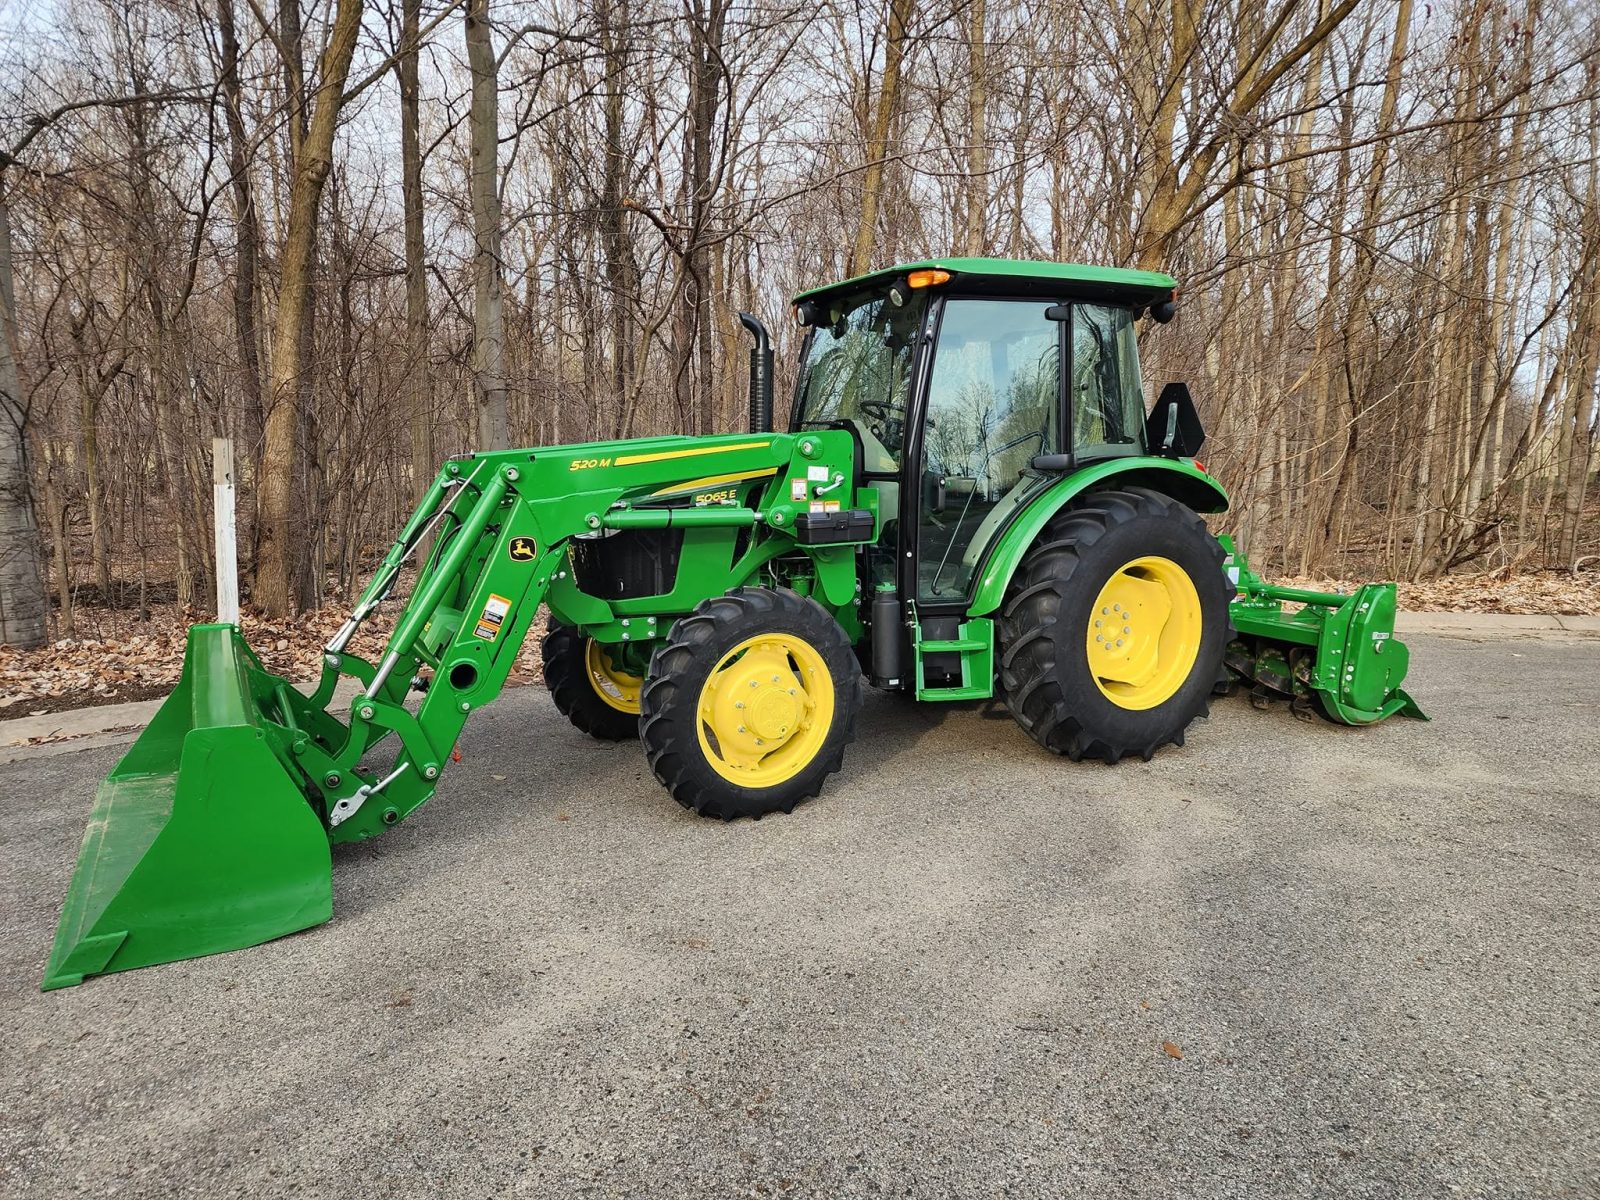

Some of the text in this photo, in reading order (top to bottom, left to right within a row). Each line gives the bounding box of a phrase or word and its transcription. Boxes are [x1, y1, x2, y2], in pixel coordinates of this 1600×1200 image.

[569, 457, 612, 471] 520 M
[695, 489, 737, 503] 5065 E
